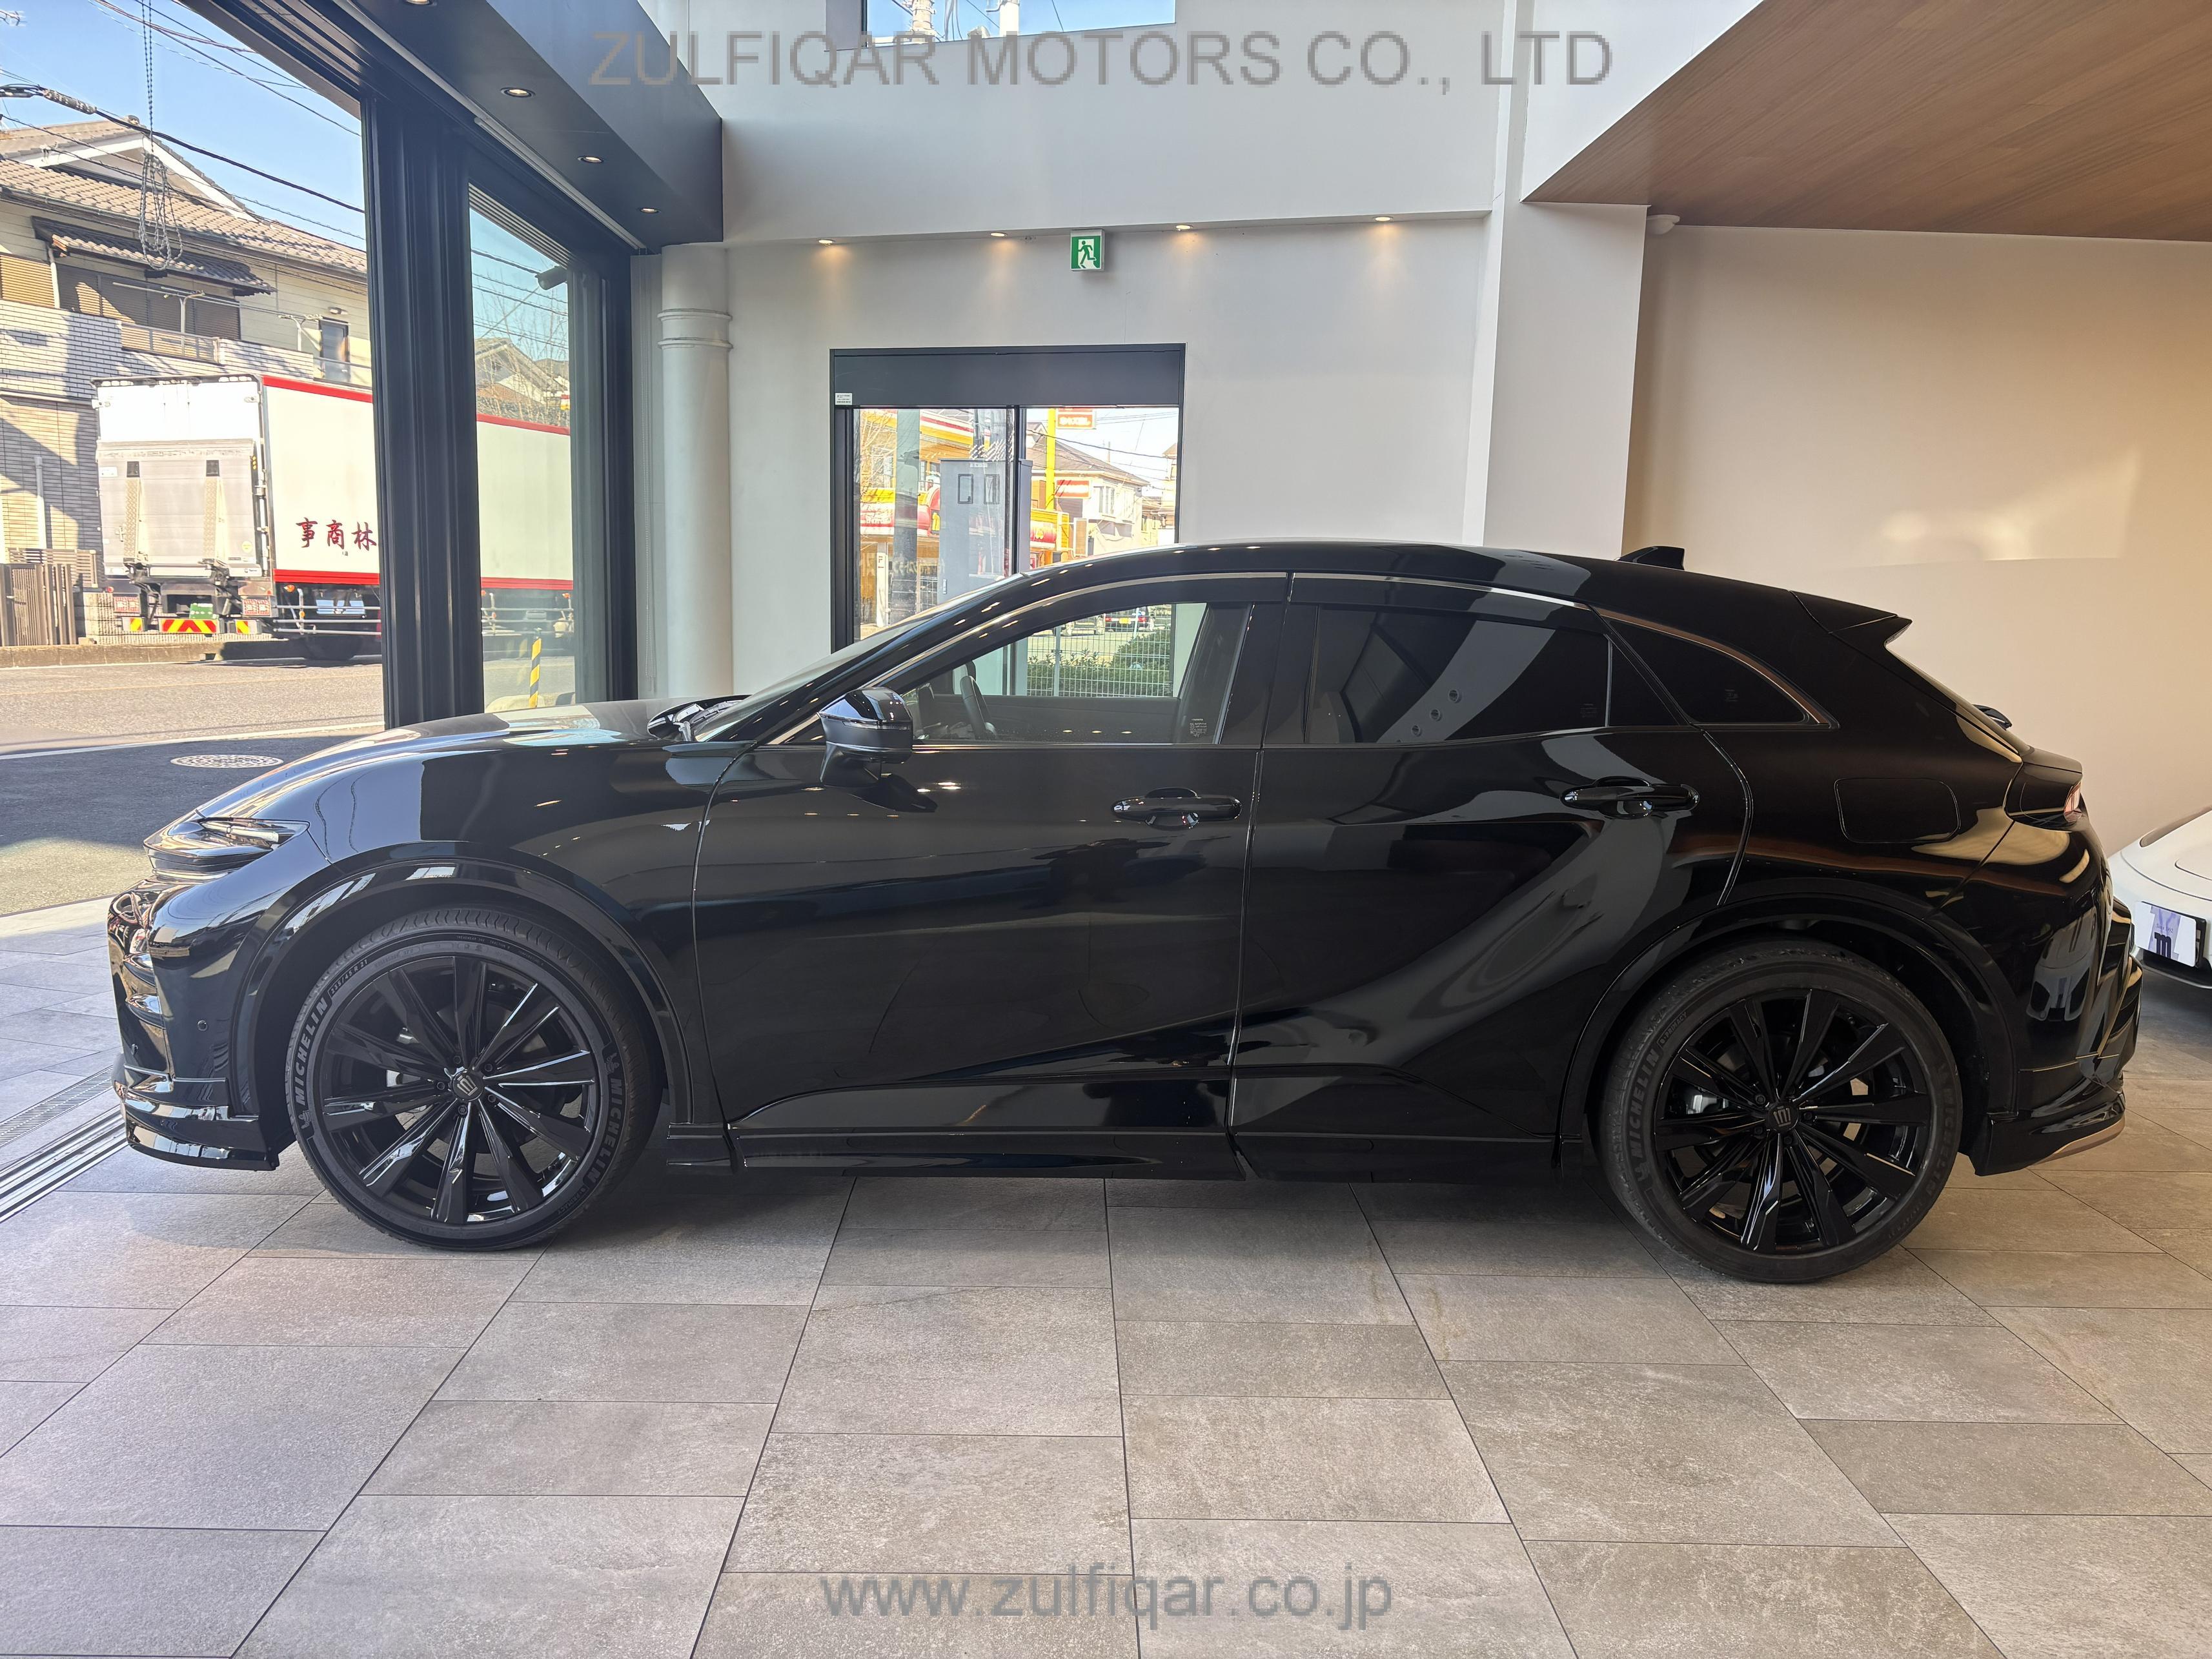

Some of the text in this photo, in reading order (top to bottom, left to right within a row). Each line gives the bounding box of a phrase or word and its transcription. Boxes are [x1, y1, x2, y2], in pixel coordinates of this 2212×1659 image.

[294, 997, 329, 1106] MICHELIN
[1629, 1048, 1659, 1159] MICHELIN
[587, 1078, 623, 1183] MICHELIN
